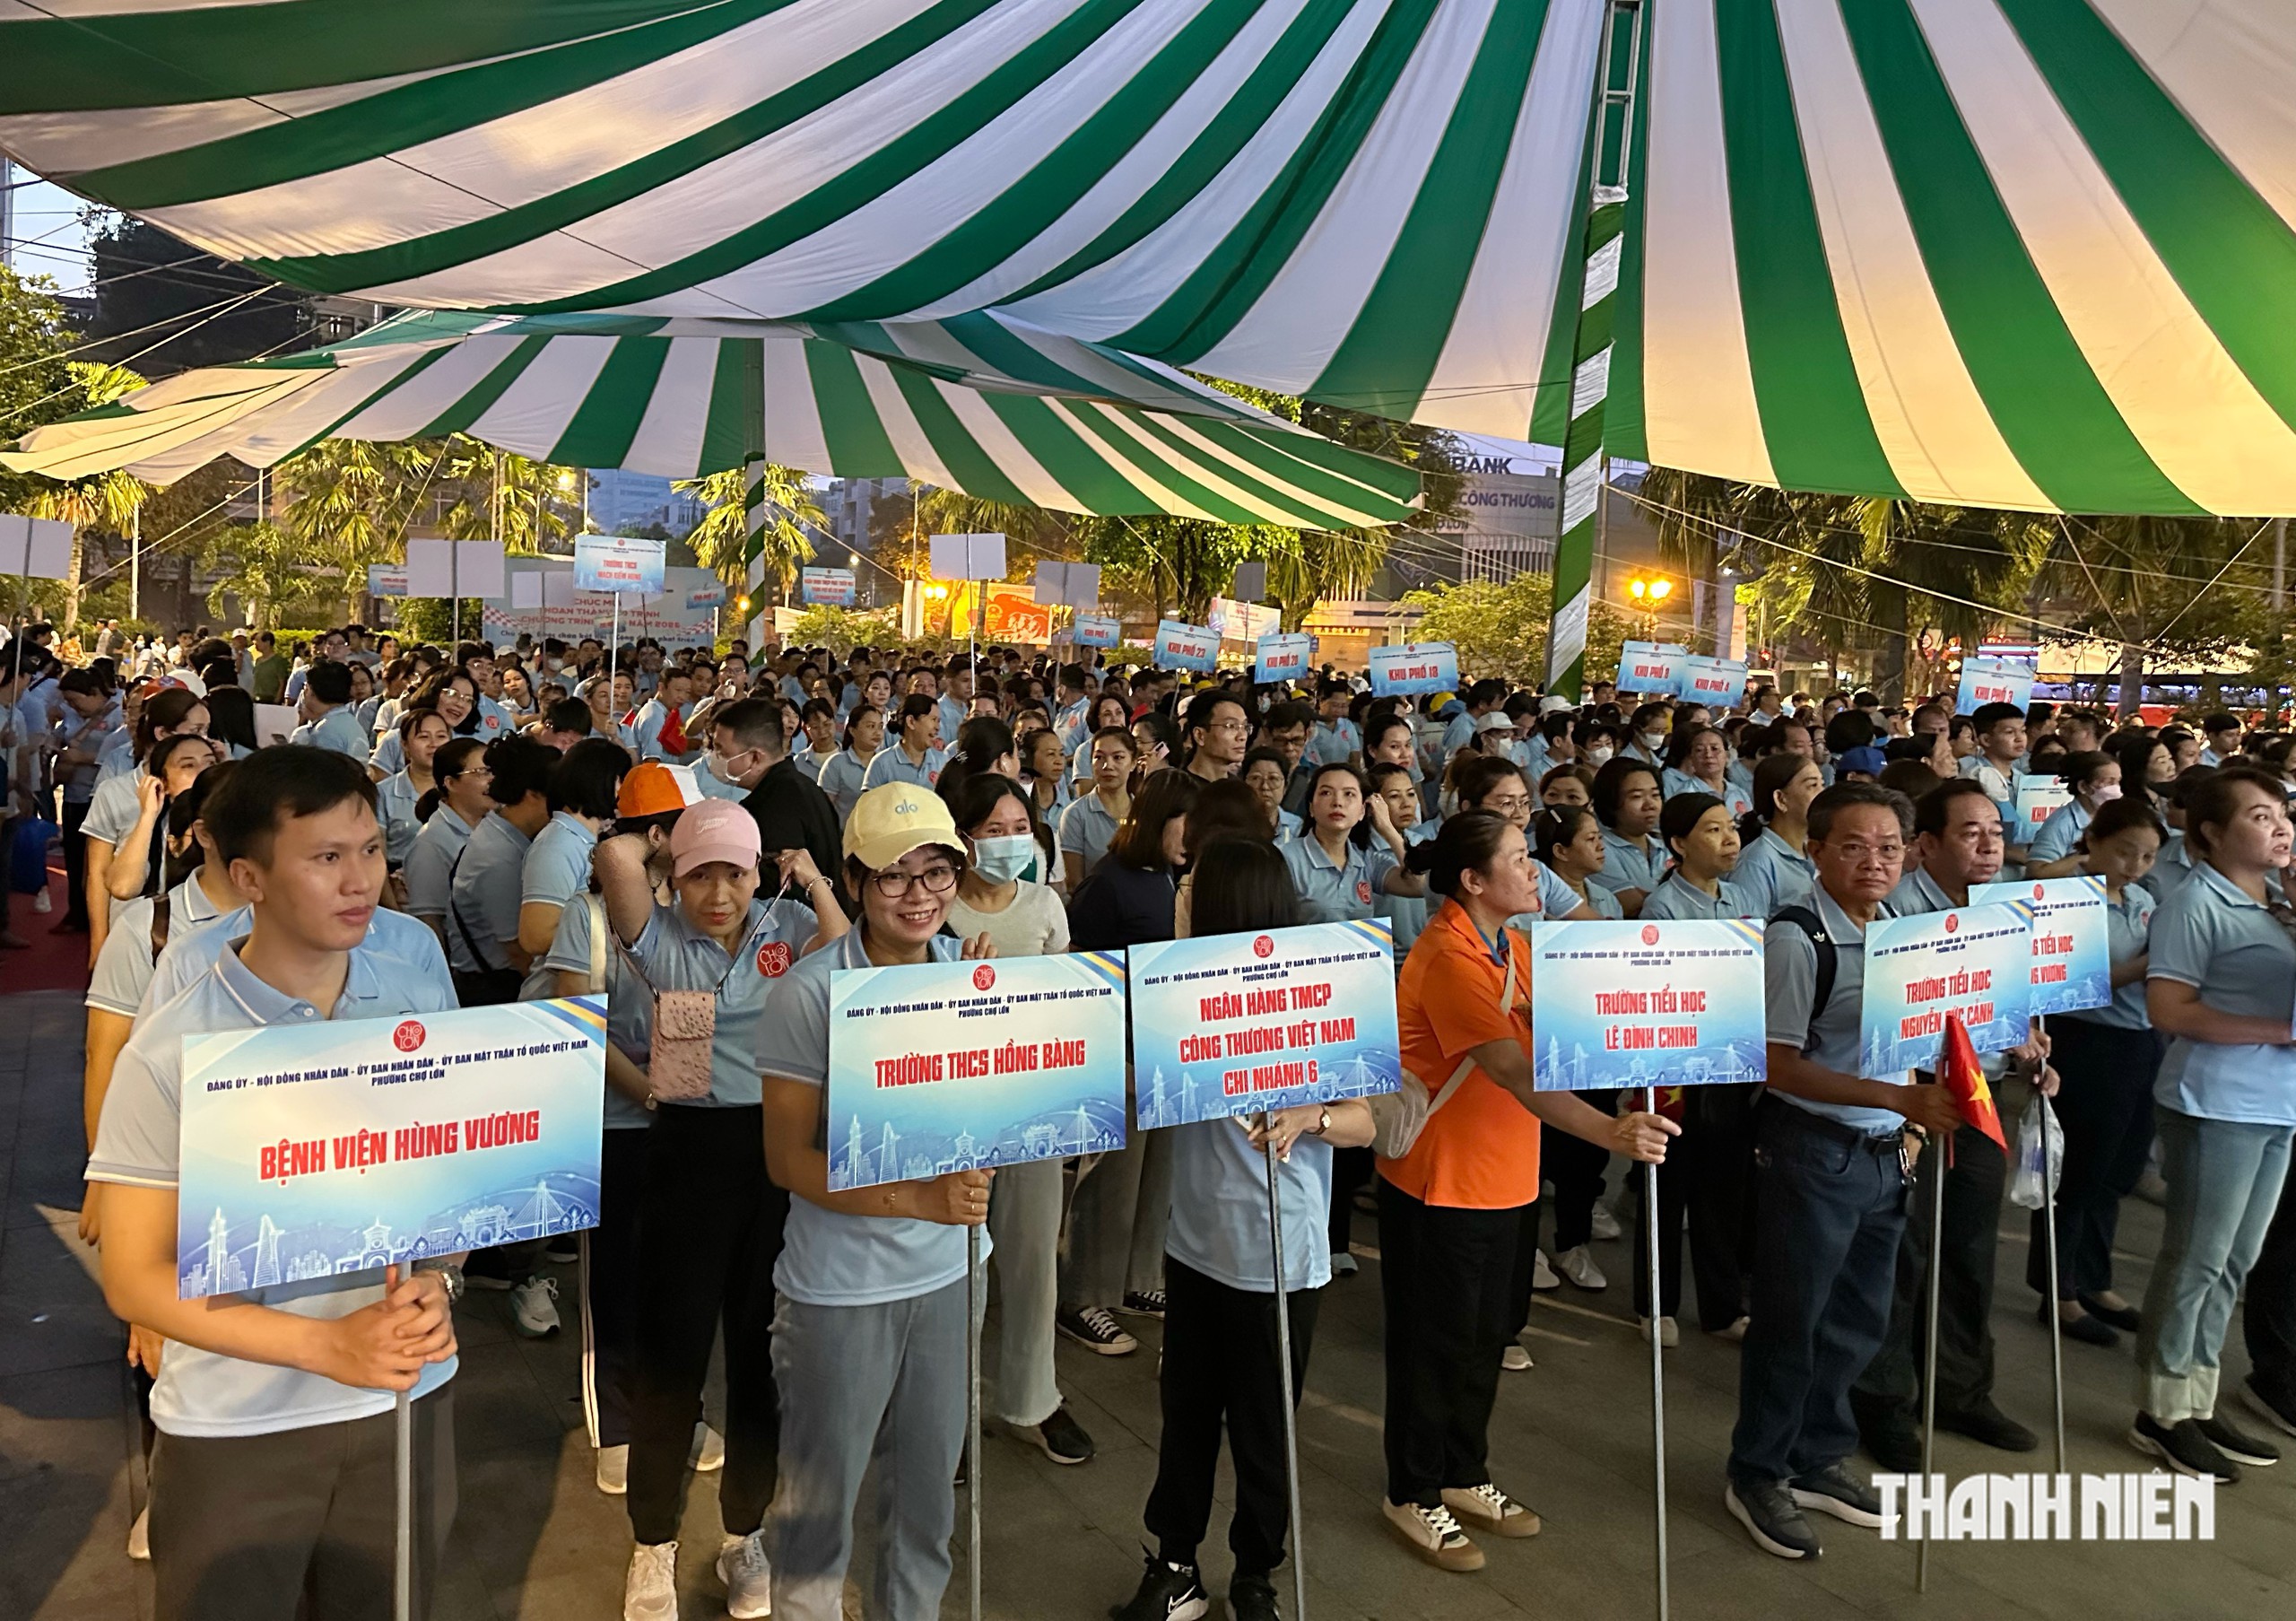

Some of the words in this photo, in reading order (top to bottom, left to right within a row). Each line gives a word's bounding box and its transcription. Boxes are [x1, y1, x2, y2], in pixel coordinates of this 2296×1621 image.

[1459, 490, 1499, 506] CÔNG
[1500, 492, 1554, 510] THƯƠNG
[1168, 641, 1181, 654] KHU
[1182, 643, 1197, 657] PHỐ
[1196, 647, 1206, 658] 23
[1266, 657, 1278, 668] KHU
[1279, 652, 1292, 667] PHỐ
[1388, 668, 1406, 681] KHU
[1408, 662, 1427, 679] PHỐ
[1429, 666, 1439, 678] 18
[1634, 665, 1648, 677] KHU
[1649, 664, 1665, 678] PHỐ
[1695, 678, 1709, 690] KHU
[1709, 678, 1725, 693] PHỐ
[1974, 686, 1990, 700] KHU
[1991, 685, 2007, 702] PHỐ
[894, 799, 918, 815] alo
[2031, 806, 2048, 823] KHU
[2039, 930, 2057, 955] TIỂU
[2057, 935, 2074, 957] HỌC
[1278, 970, 1289, 978] LỚN
[1906, 976, 1946, 1005] TRƯỜNG
[1948, 965, 1969, 997] TIỂU
[1971, 969, 1992, 996] HỌC
[865, 1006, 874, 1016] ỦY
[880, 1005, 891, 1015] HỘI
[893, 1002, 910, 1014] ĐỒNG
[912, 1001, 929, 1012] NHÂN
[930, 1000, 943, 1011] DÂN
[948, 998, 956, 1009] ỦY
[958, 999, 970, 1008] BAN
[971, 996, 987, 1006] NHÂN
[989, 995, 1002, 1005] DÂN
[1006, 994, 1015, 1004] ỦY
[1016, 994, 1029, 1003] BAN
[1059, 989, 1067, 999] TỔ
[1068, 989, 1084, 999] QUỐC
[1085, 988, 1098, 998] VIỆT
[1099, 987, 1112, 996] NAM
[958, 1007, 983, 1018] PHƯỜNG
[984, 1007, 997, 1016] CHỢ
[998, 1006, 1010, 1015] LỚN
[1200, 991, 1243, 1022] NGÂN
[1247, 988, 1287, 1016] HÀNG
[1290, 983, 1332, 1010] TMCP
[1595, 989, 1647, 1015] TRƯỜNG
[1650, 983, 1678, 1014] TIỂU
[1681, 990, 1706, 1018] HỌC
[1900, 1007, 1942, 1040] NGUYỄN
[1967, 998, 1994, 1026] CẢNH
[1179, 1034, 1221, 1063] CÔNG
[1224, 1027, 1284, 1057] THƯƠNG
[1286, 1019, 1317, 1052] VIỆT
[1320, 1017, 1356, 1044] NAM
[1605, 1025, 1619, 1050] LÊ
[1622, 1024, 1655, 1049] ĐÌNH
[1658, 1026, 1698, 1048] CHINH
[235, 1076, 248, 1089] ỦY
[257, 1074, 273, 1088] HỘI
[275, 1071, 301, 1085] ĐỒNG
[303, 1068, 328, 1082] NHÂN
[331, 1066, 349, 1079] DÂN
[357, 1063, 369, 1076] ỦY
[371, 1063, 388, 1075] BAN
[391, 1059, 414, 1072] NHÂN
[416, 1058, 434, 1069] DÂN
[441, 1053, 453, 1066] ỦY
[455, 1053, 472, 1065] BAN
[517, 1044, 526, 1058] TỔ
[529, 1042, 551, 1057] QUỐC
[552, 1041, 569, 1053] VIỆT
[571, 1040, 588, 1050] NAM
[874, 1051, 943, 1089] TRƯỜNG
[947, 1049, 989, 1080] THCS
[994, 1038, 1038, 1075] HỒNG
[1042, 1037, 1085, 1069] BÀNG
[371, 1072, 407, 1087] PHƯỜNG
[409, 1069, 427, 1083] CHỢ
[430, 1068, 445, 1080] LỚN
[1224, 1069, 1248, 1095] CHI
[1253, 1060, 1304, 1092] NHÁNH
[1308, 1060, 1318, 1084] 6
[260, 1138, 326, 1186] BỆNH
[333, 1128, 387, 1174] VIỆN
[395, 1121, 458, 1162] HÙNG
[465, 1110, 540, 1151] VƯƠNG
